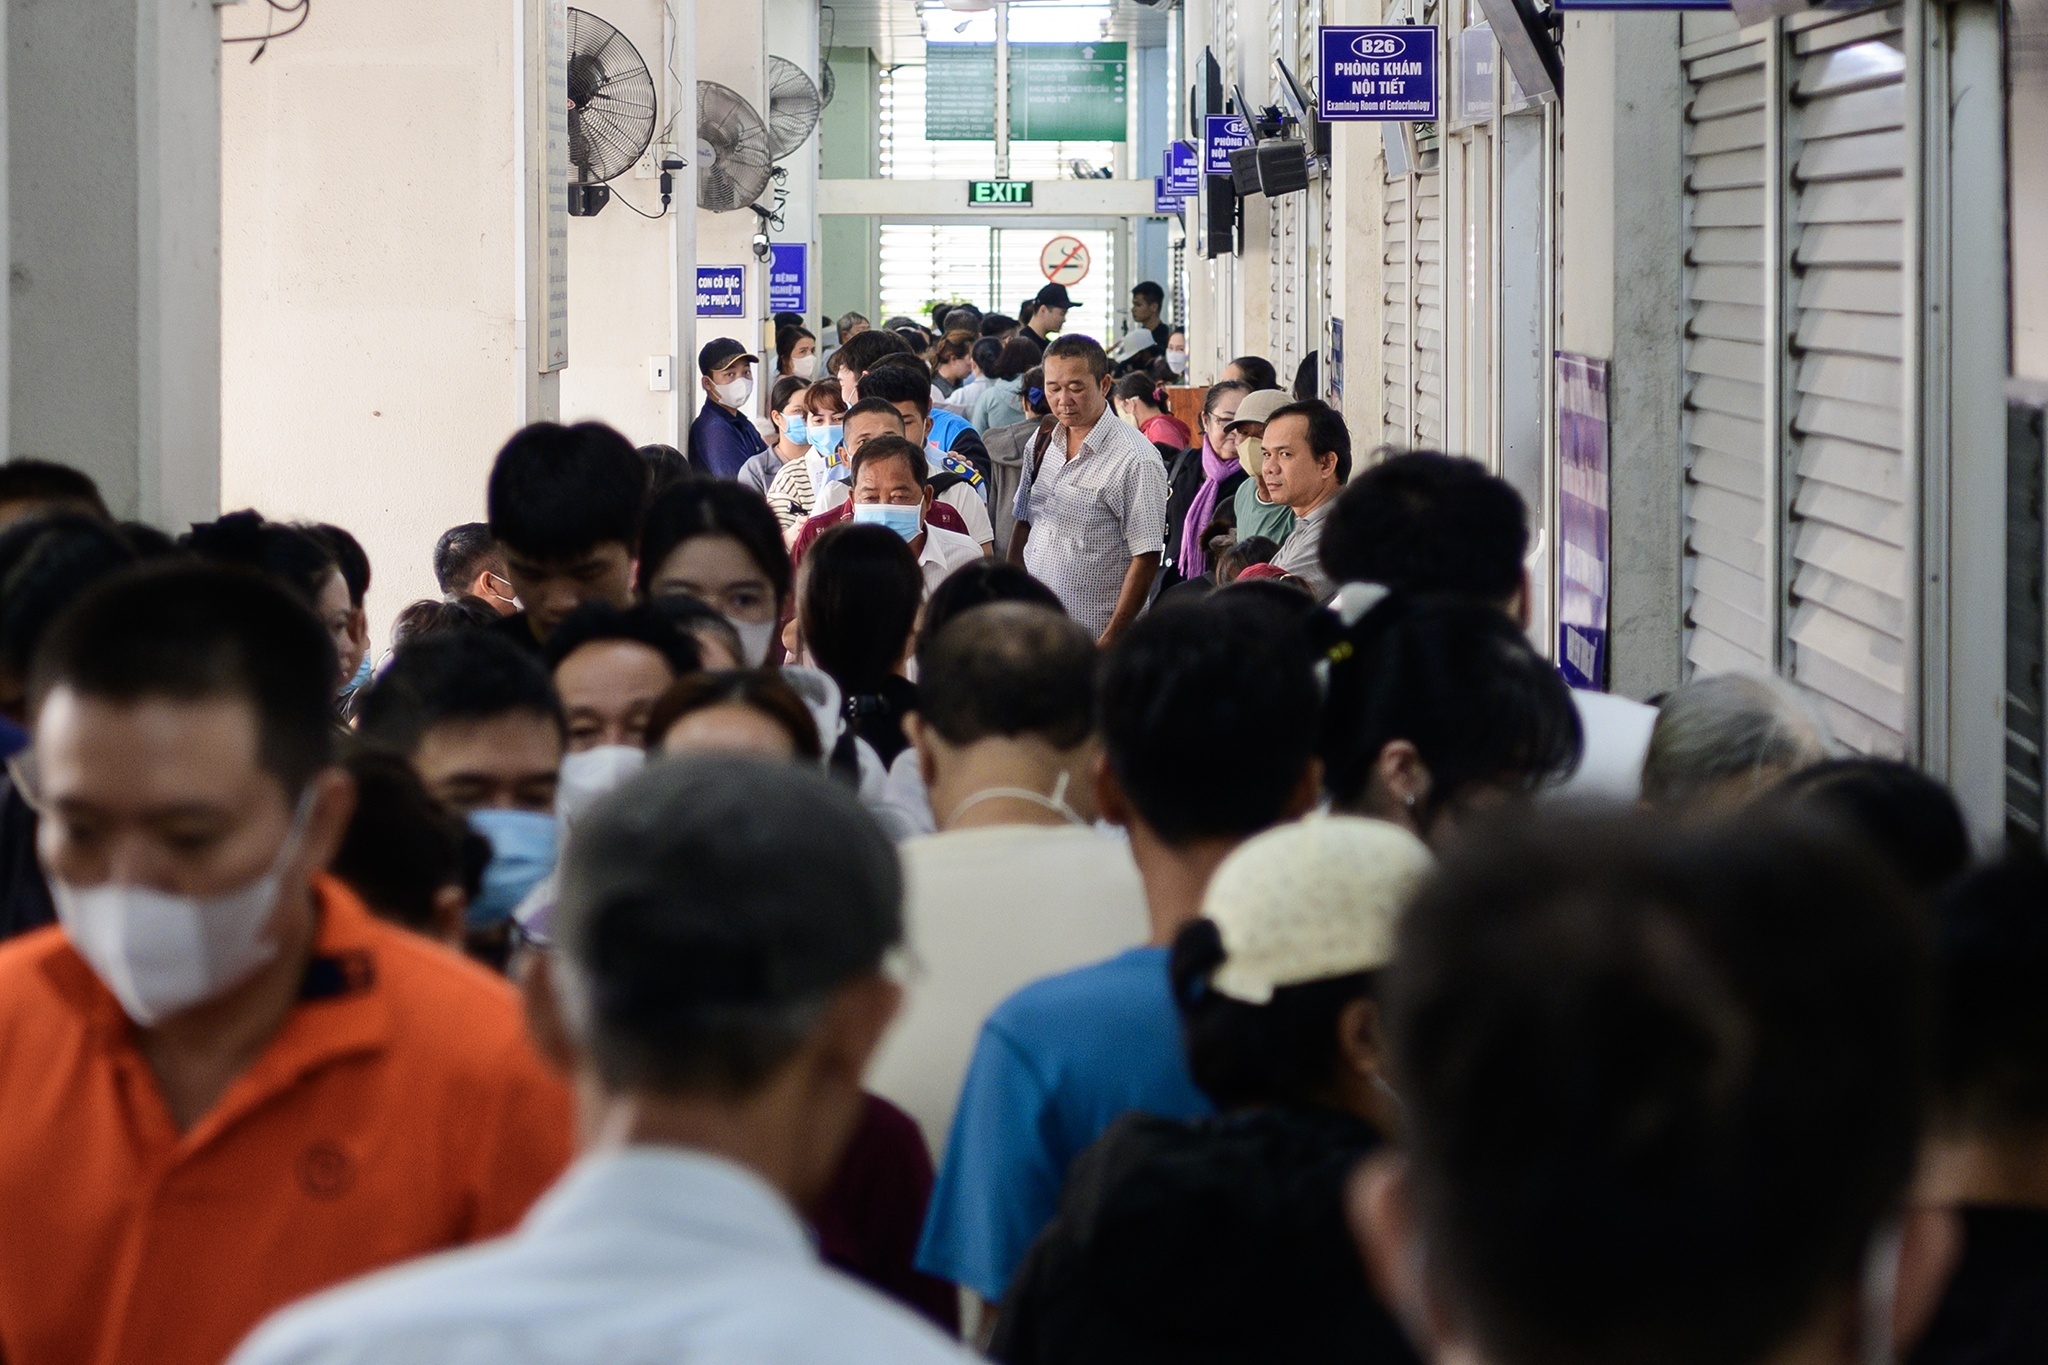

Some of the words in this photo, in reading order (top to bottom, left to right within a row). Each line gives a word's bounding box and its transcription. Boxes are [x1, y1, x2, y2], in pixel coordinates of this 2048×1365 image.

[1361, 39, 1395, 54] B26
[1334, 59, 1380, 76] PHÒNG
[1383, 59, 1422, 76] KHÁM
[1351, 80, 1375, 98] NỘI
[1378, 77, 1406, 95] TIẾT
[1327, 100, 1360, 111] Examining
[1360, 100, 1379, 111] Room
[1379, 100, 1386, 111] of
[1387, 100, 1430, 112] Endocrinology
[1231, 123, 1245, 133] B2
[1211, 147, 1226, 159] NỘI
[975, 182, 1027, 202] EXIT
[698, 277, 712, 288] CON
[713, 275, 724, 288] CÔ
[724, 275, 740, 288] BÁC
[775, 272, 798, 284] BỆNH
[696, 293, 710, 308] ƯỢC
[711, 294, 730, 308] PHỤC
[730, 294, 741, 307] VỤ
